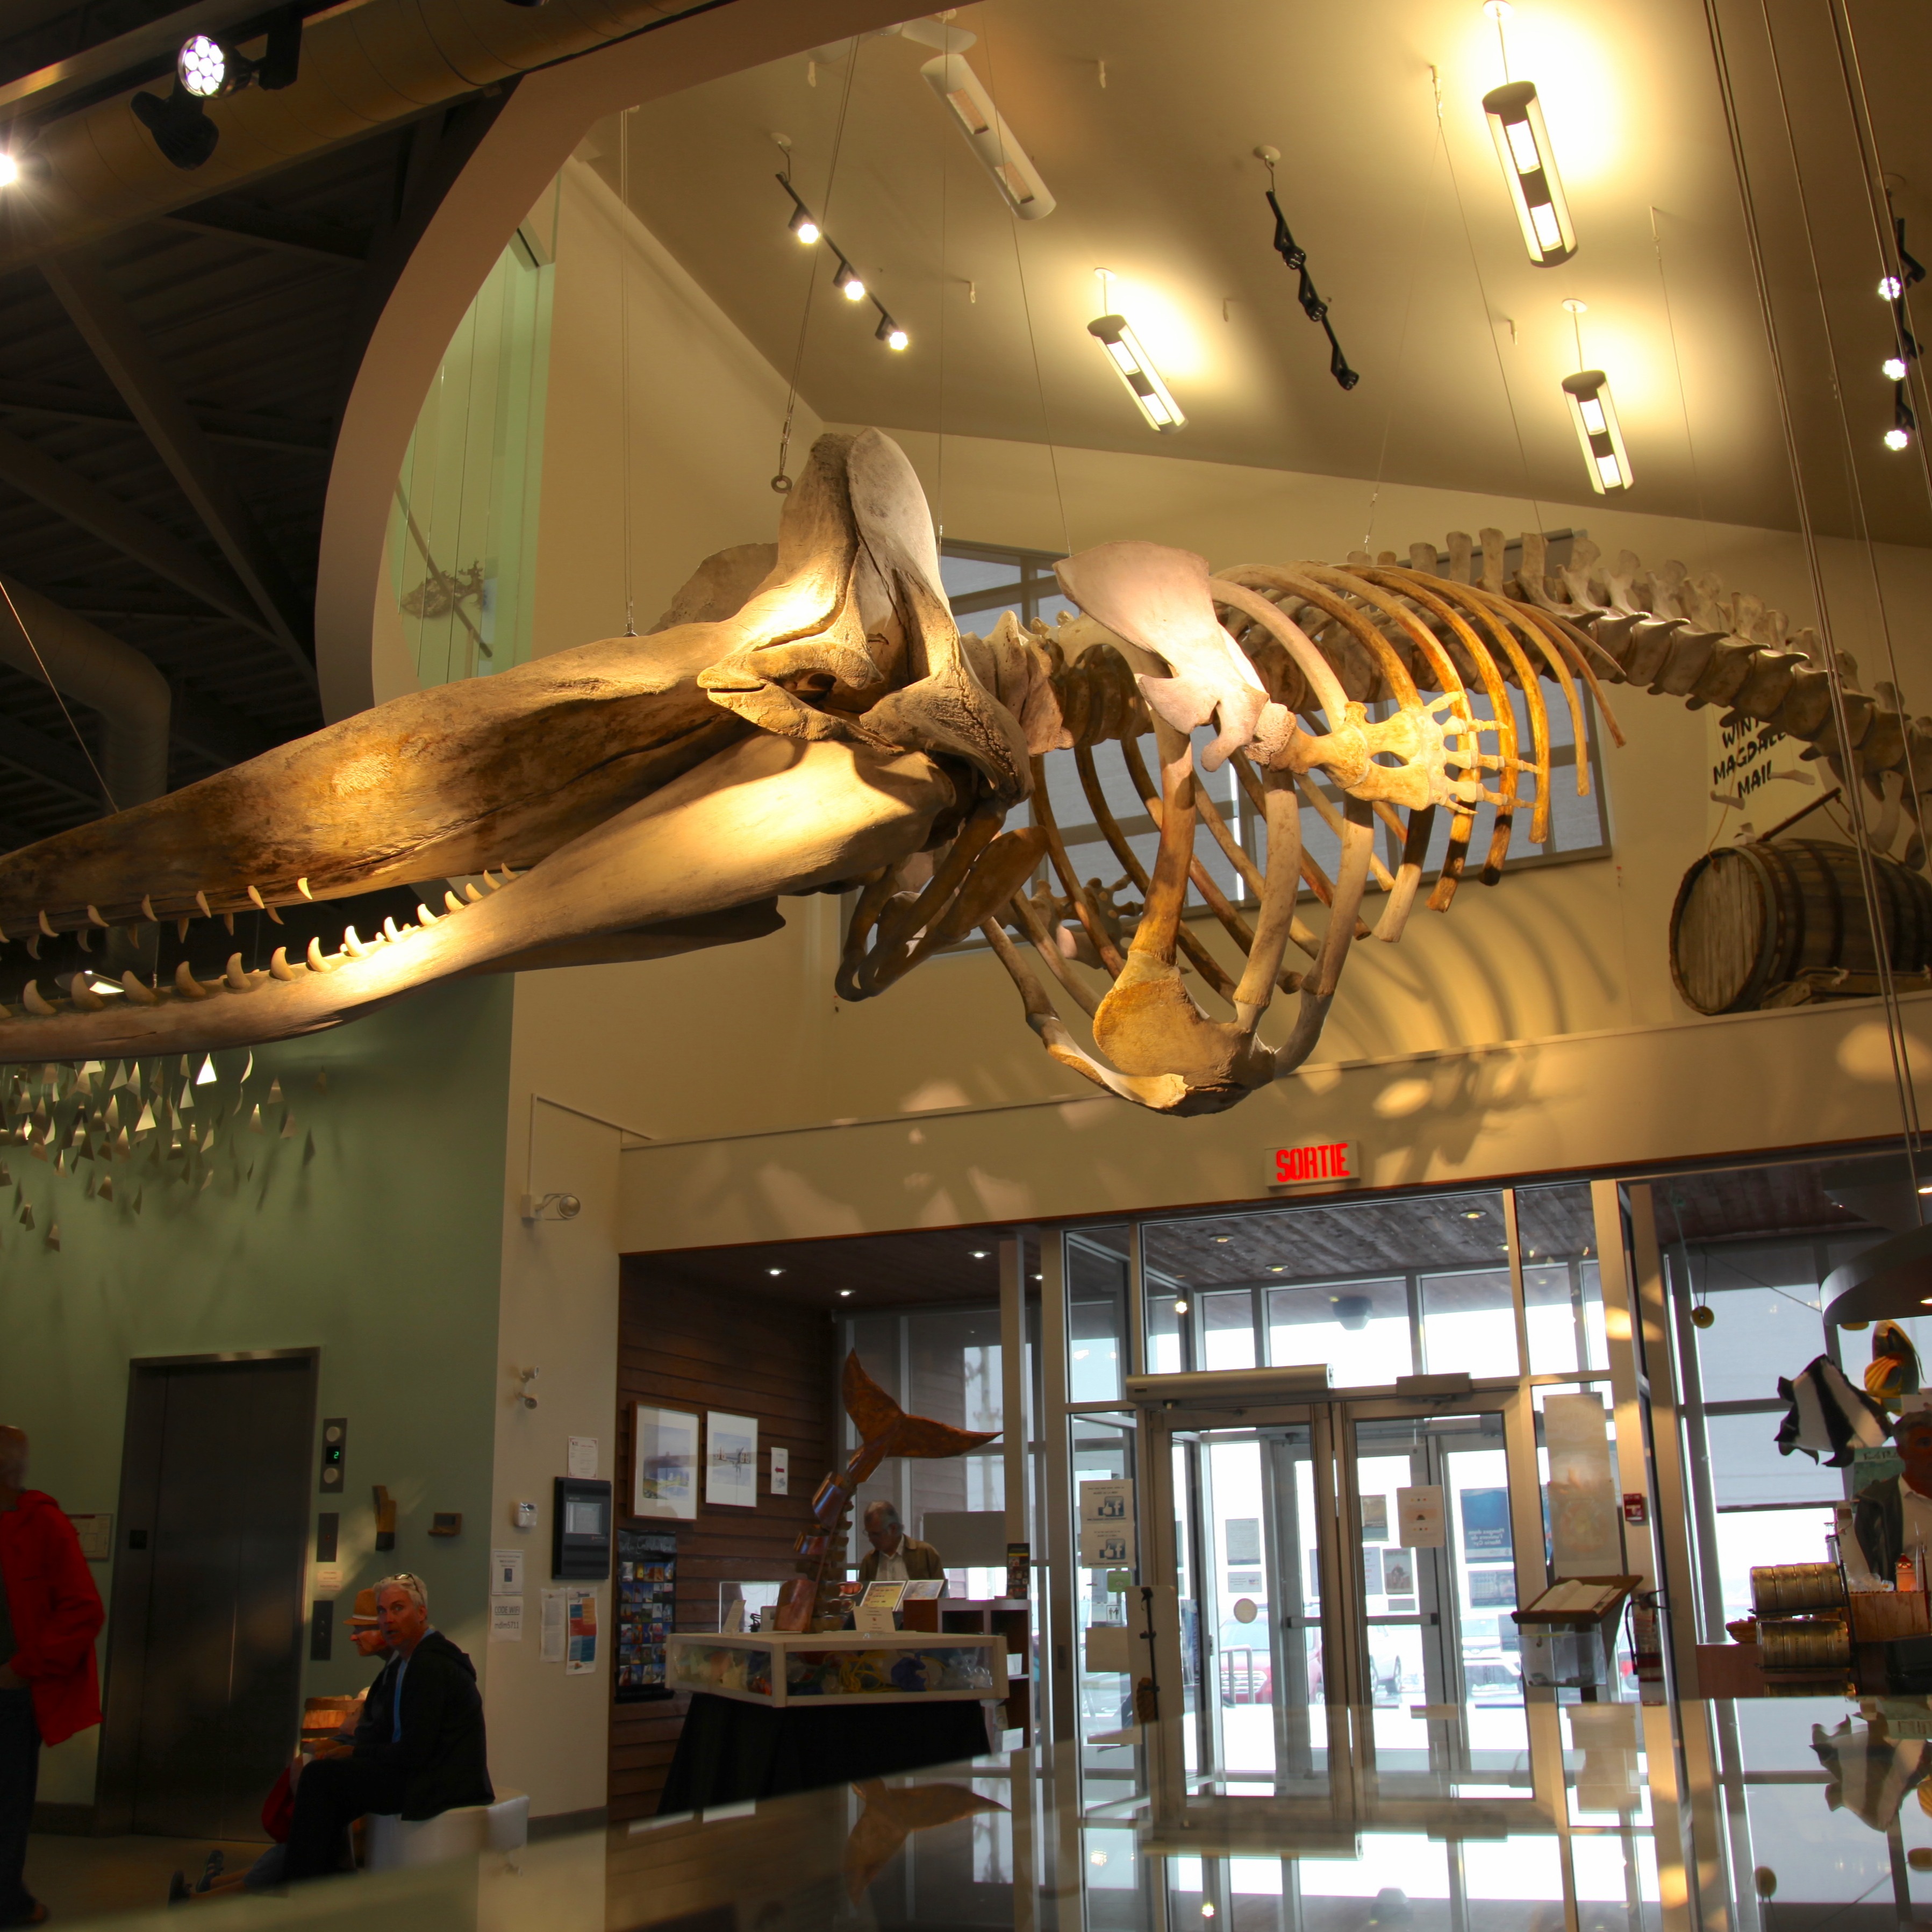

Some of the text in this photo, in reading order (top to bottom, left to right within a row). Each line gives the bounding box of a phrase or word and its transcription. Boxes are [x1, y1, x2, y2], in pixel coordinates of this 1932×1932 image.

[1737, 760, 1772, 798] MAIL
[1276, 1142, 1350, 1183] SORTIE
[495, 1606, 520, 1614] CODE WIFI
